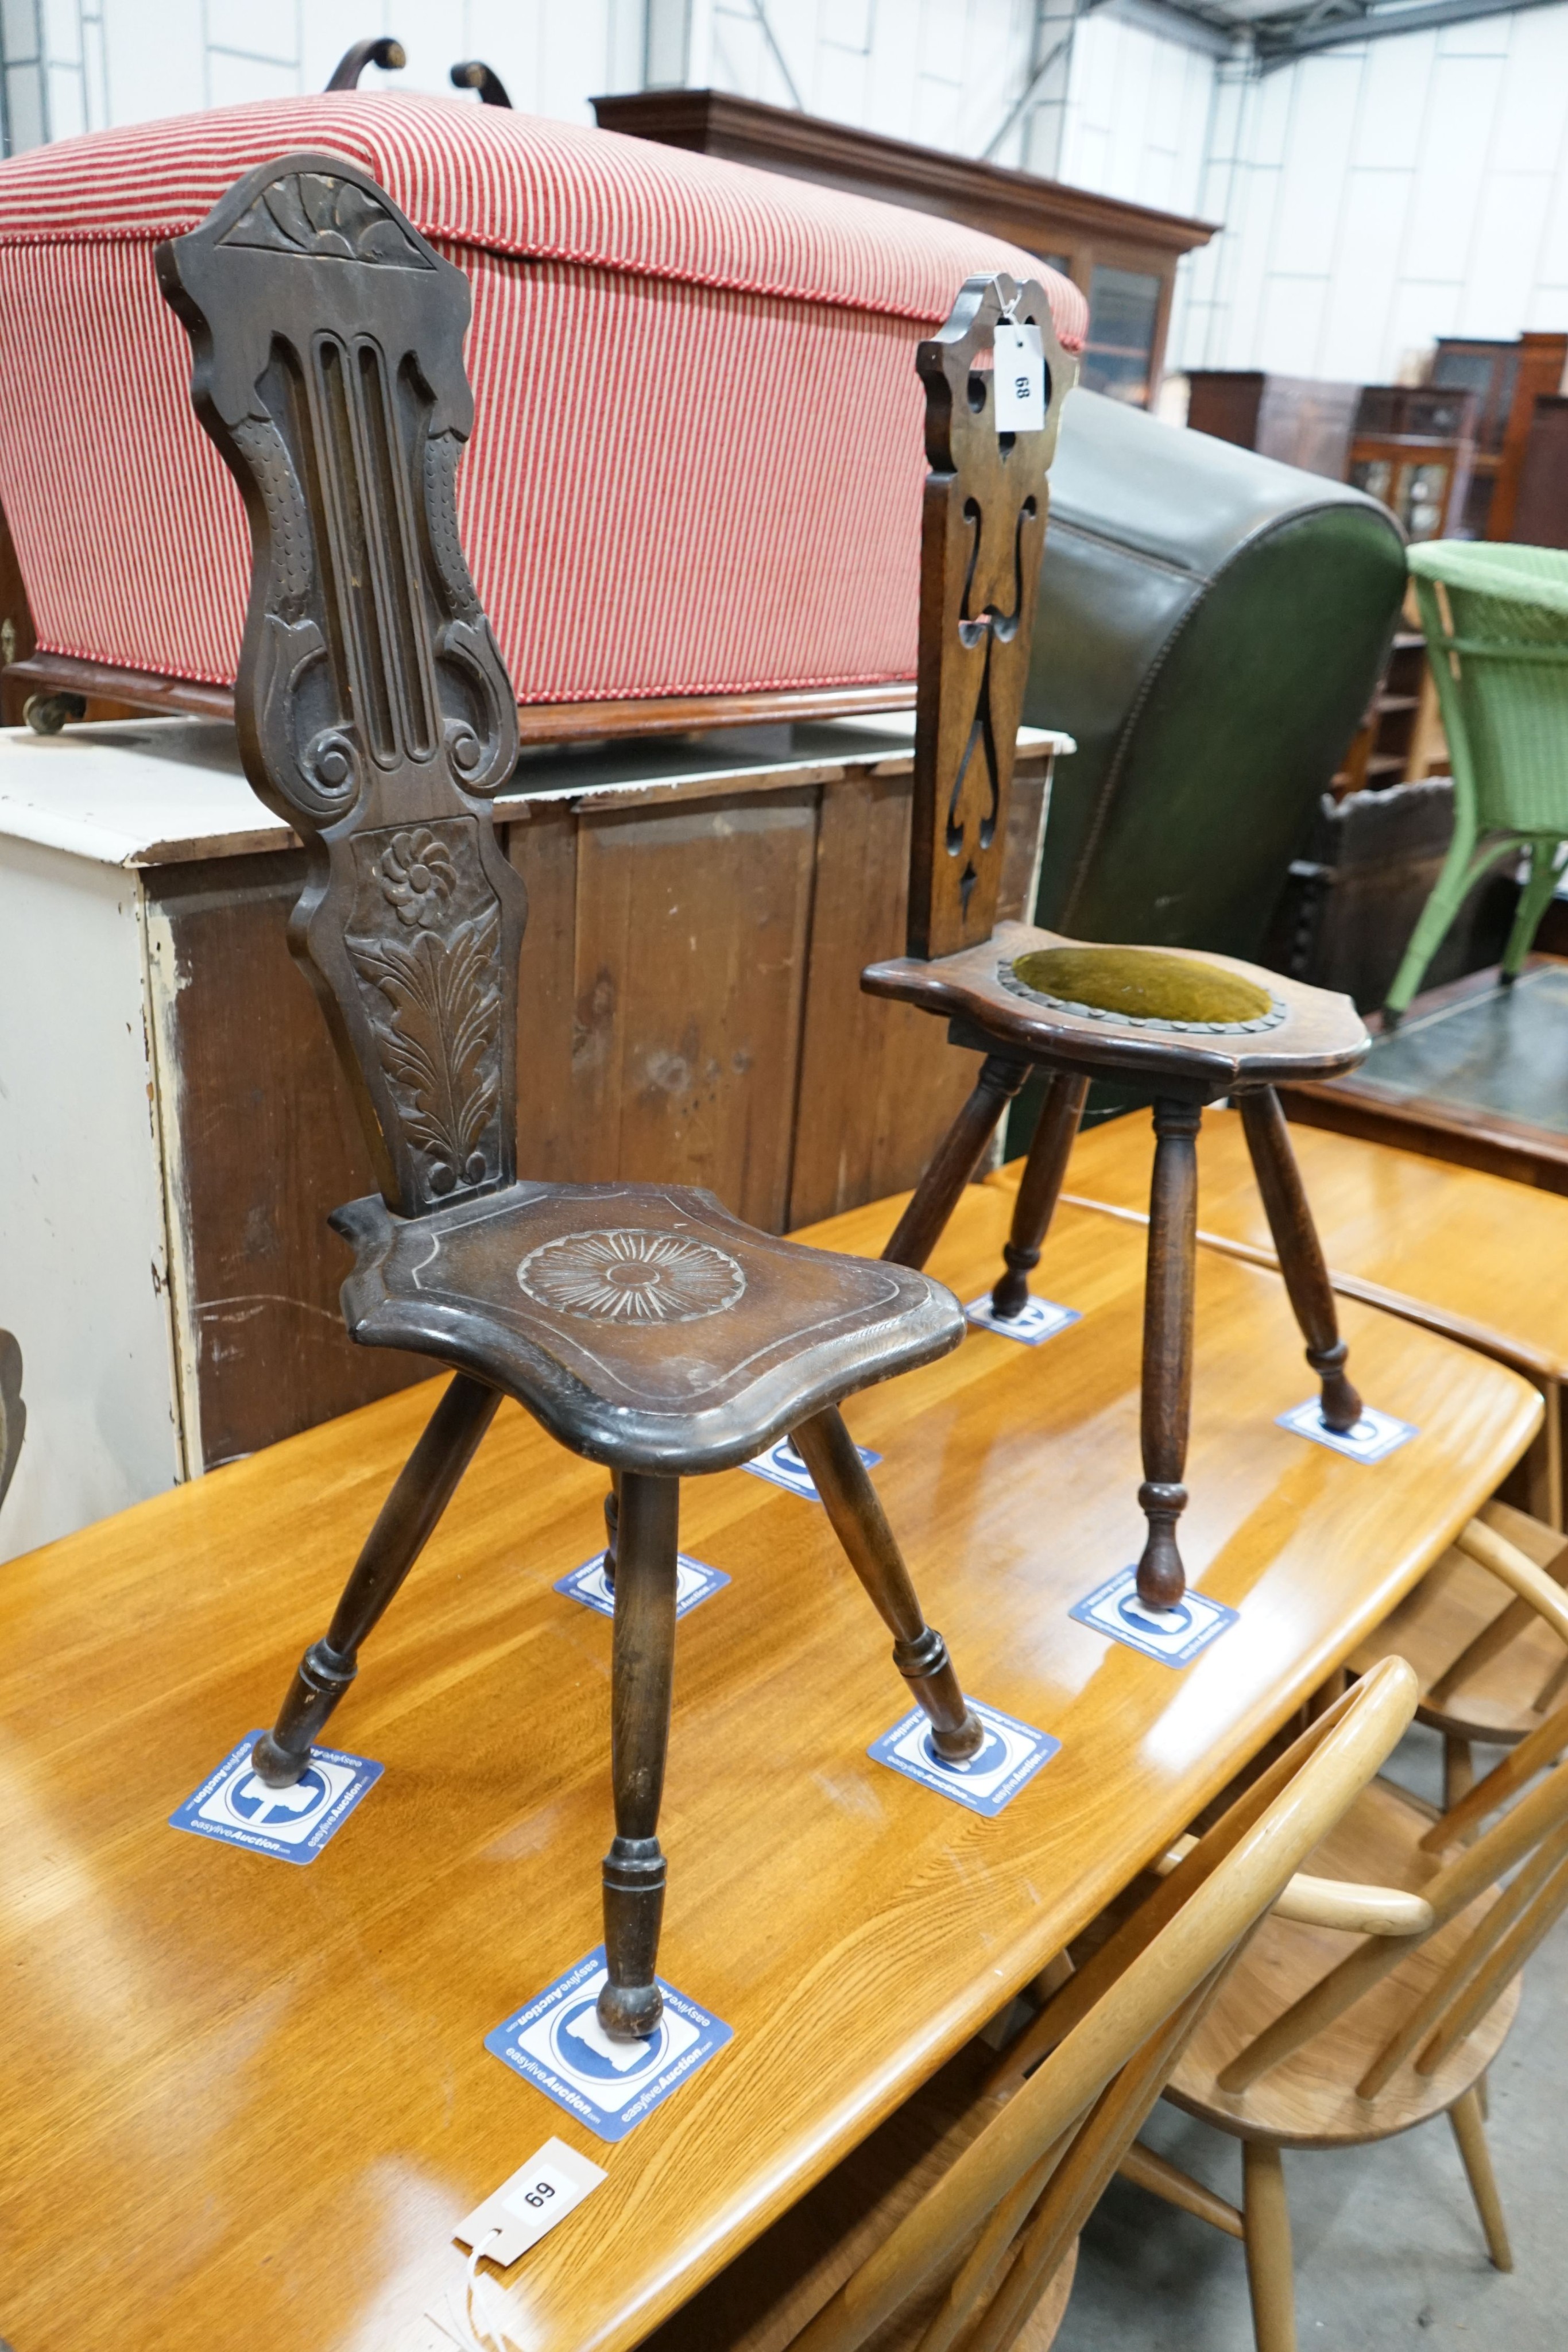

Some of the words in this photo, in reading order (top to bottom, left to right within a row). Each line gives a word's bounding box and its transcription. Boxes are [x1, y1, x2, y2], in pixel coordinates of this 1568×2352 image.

[1015, 376, 1030, 399] 68
[506, 2048, 601, 2125] easyliveAuction.com
[621, 2041, 713, 2122] easyliveAuction.com
[525, 2182, 556, 2208] 69
